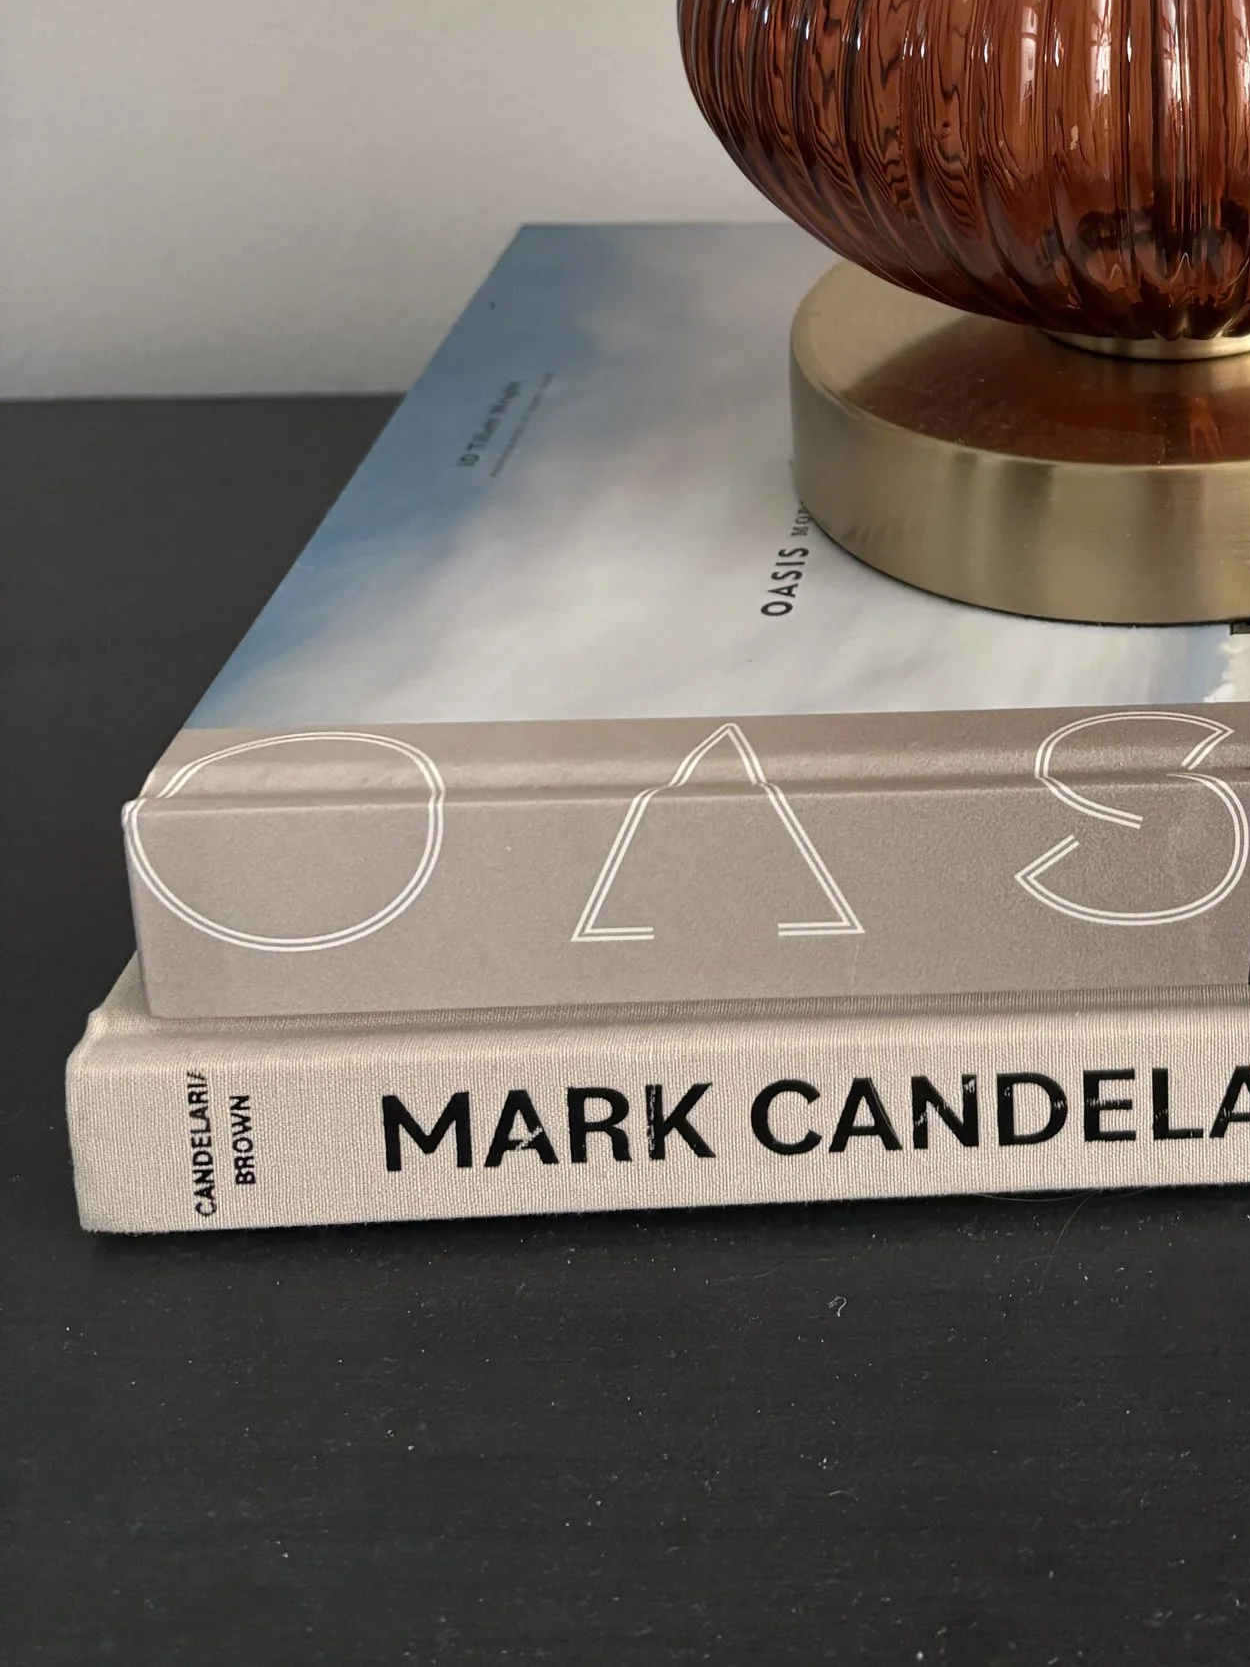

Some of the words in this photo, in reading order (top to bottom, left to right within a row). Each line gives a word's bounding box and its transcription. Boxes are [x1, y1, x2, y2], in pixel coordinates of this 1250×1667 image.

[760, 547, 809, 617] OASIS
[229, 1094, 256, 1185] BROWN
[381, 1082, 717, 1172] MARK
